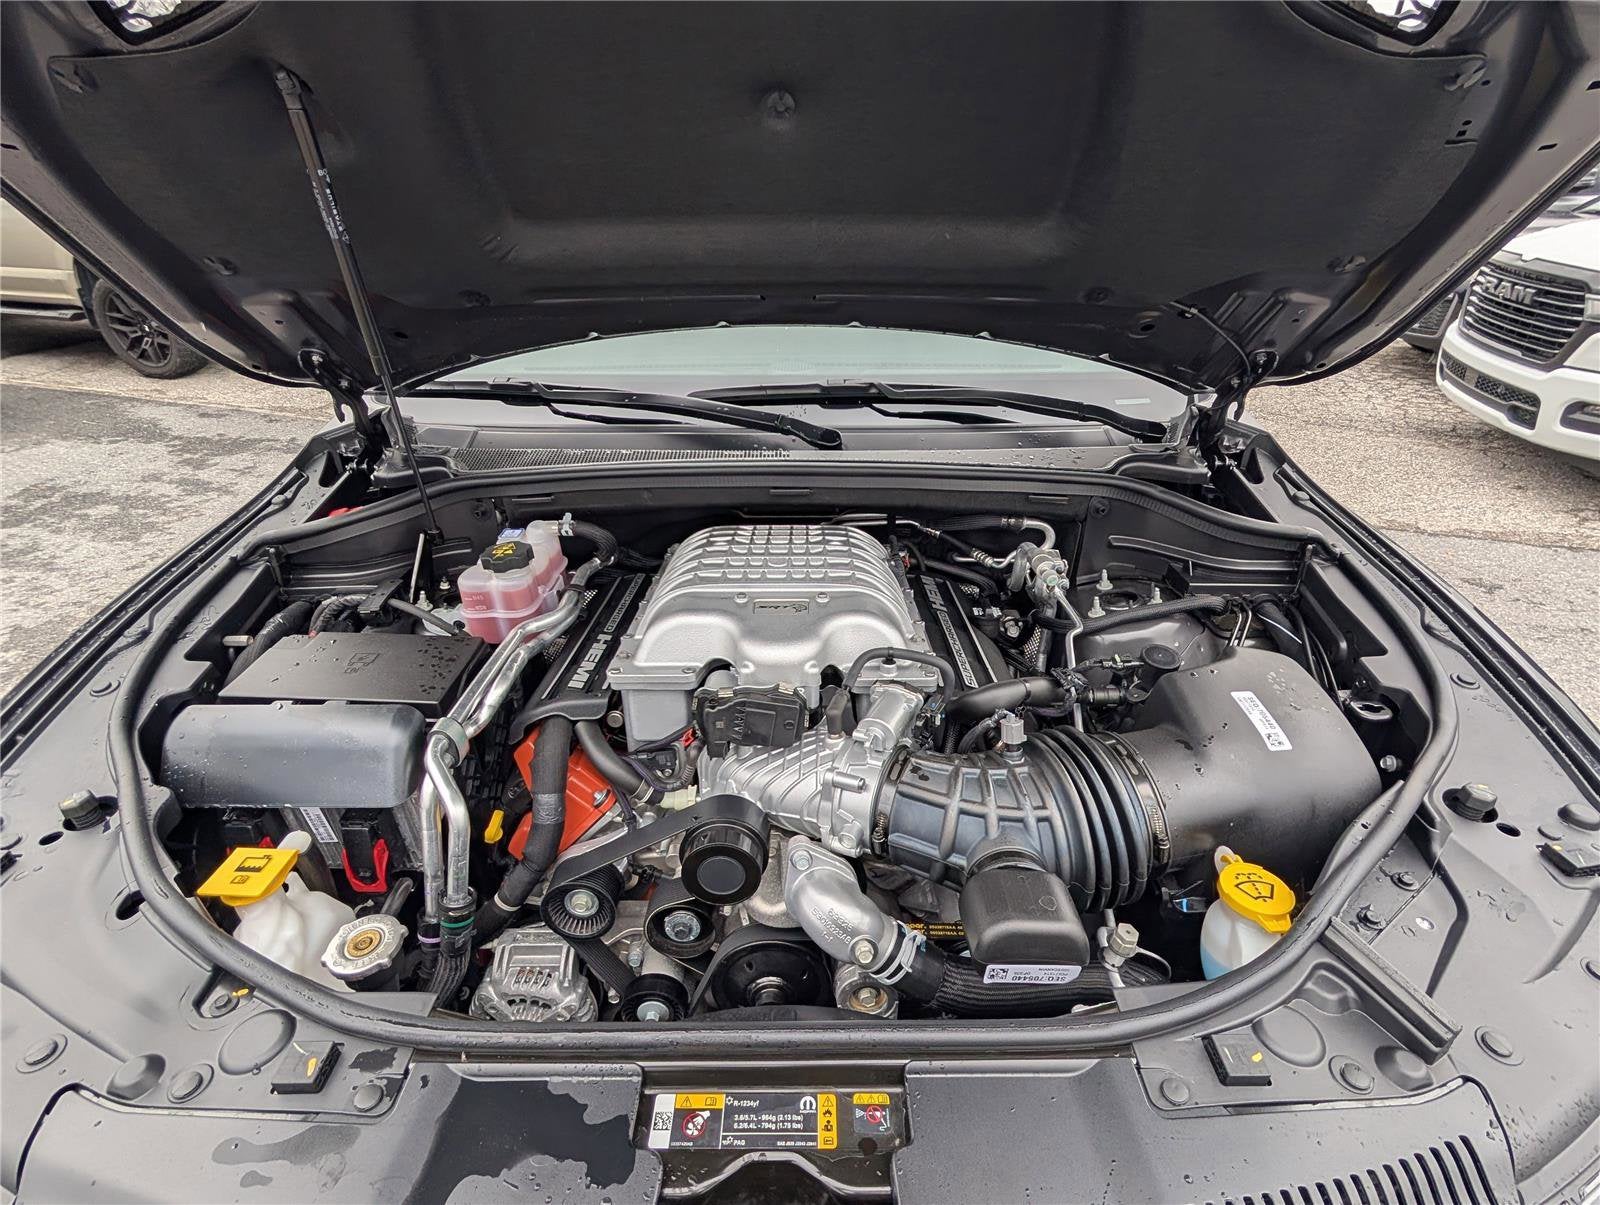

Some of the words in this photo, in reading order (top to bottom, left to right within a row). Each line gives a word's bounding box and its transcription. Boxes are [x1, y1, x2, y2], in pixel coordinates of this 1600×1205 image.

[1481, 274, 1537, 305] RAM
[604, 573, 645, 632] SUPERCHARGED
[567, 633, 612, 689] HEMI
[937, 611, 978, 688] SUPERCHARGED
[733, 1099, 760, 1108] R-1234yf
